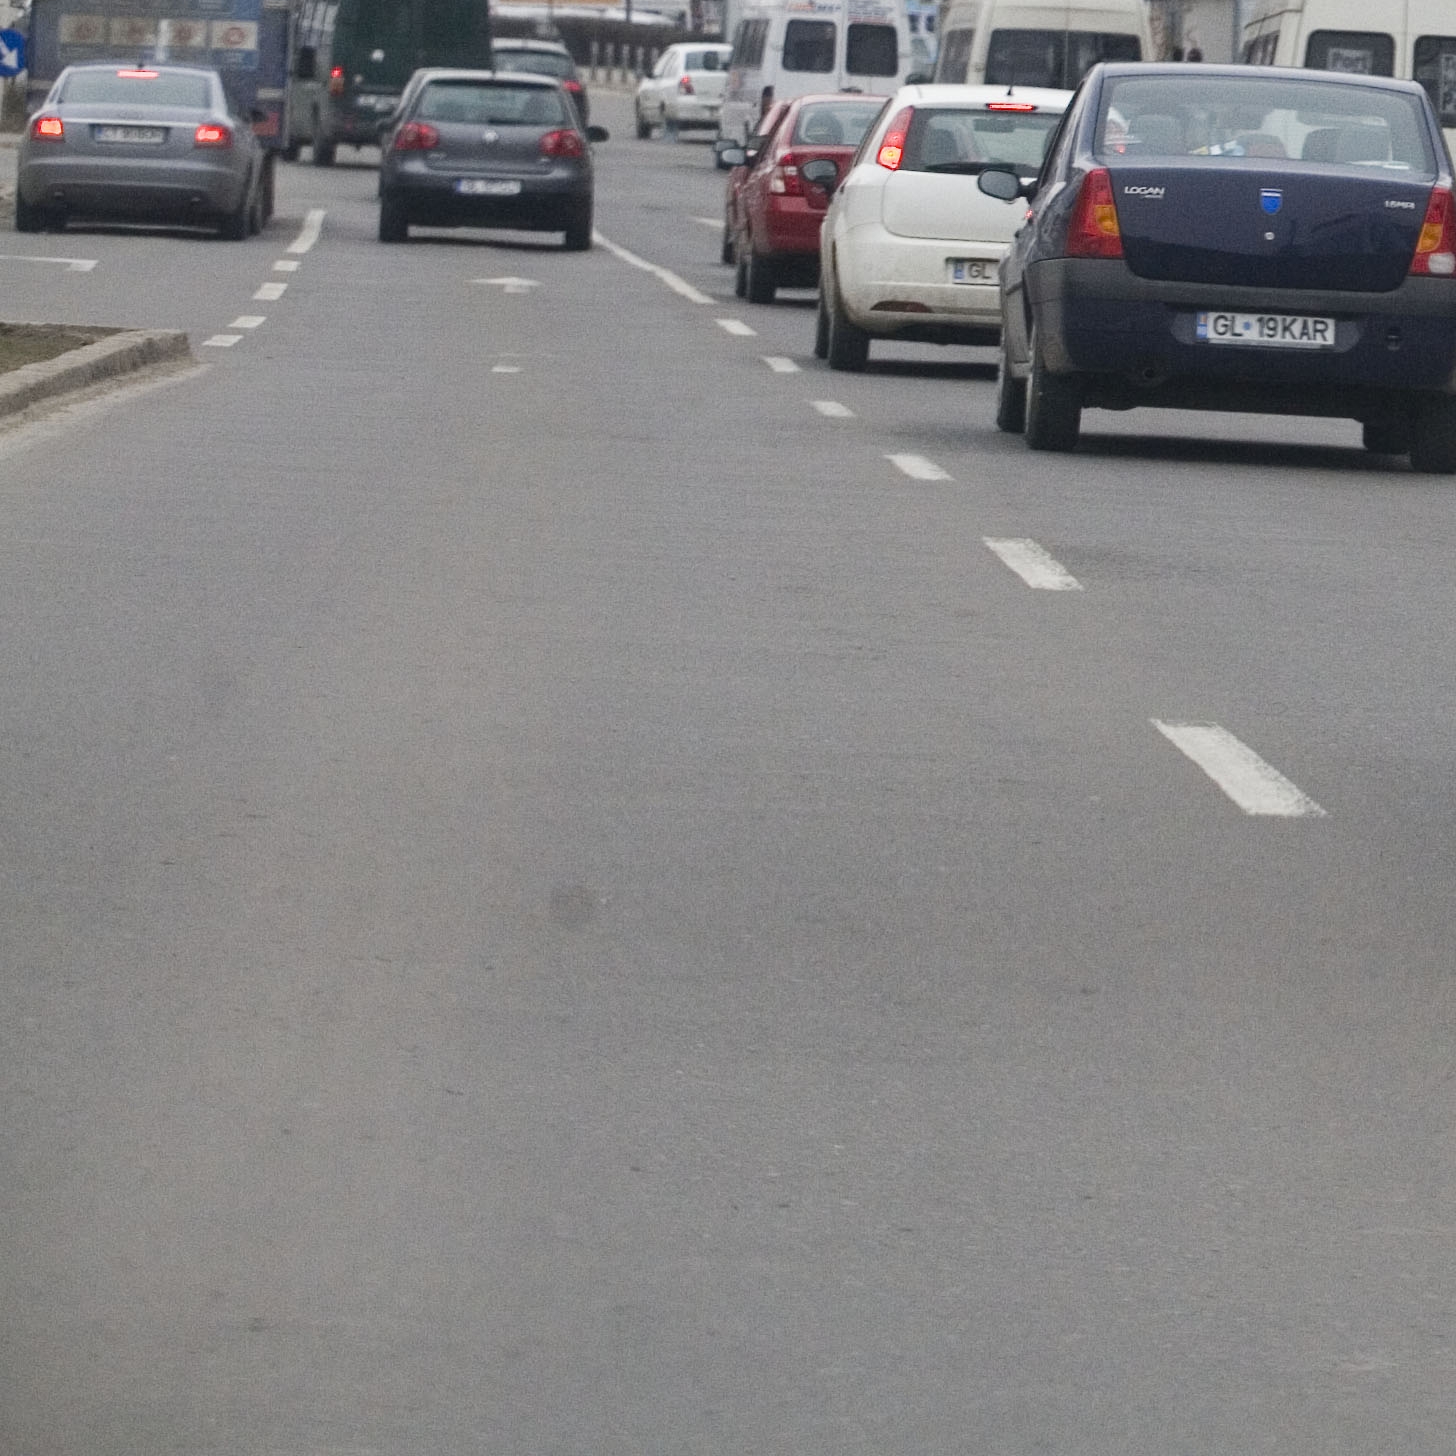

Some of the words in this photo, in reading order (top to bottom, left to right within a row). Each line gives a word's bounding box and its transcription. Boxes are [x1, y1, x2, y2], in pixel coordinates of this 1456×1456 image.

[1124, 186, 1165, 196] LOGAN
[968, 263, 992, 280] GL
[1213, 314, 1243, 338] GL
[1257, 316, 1329, 342] 19KAR
